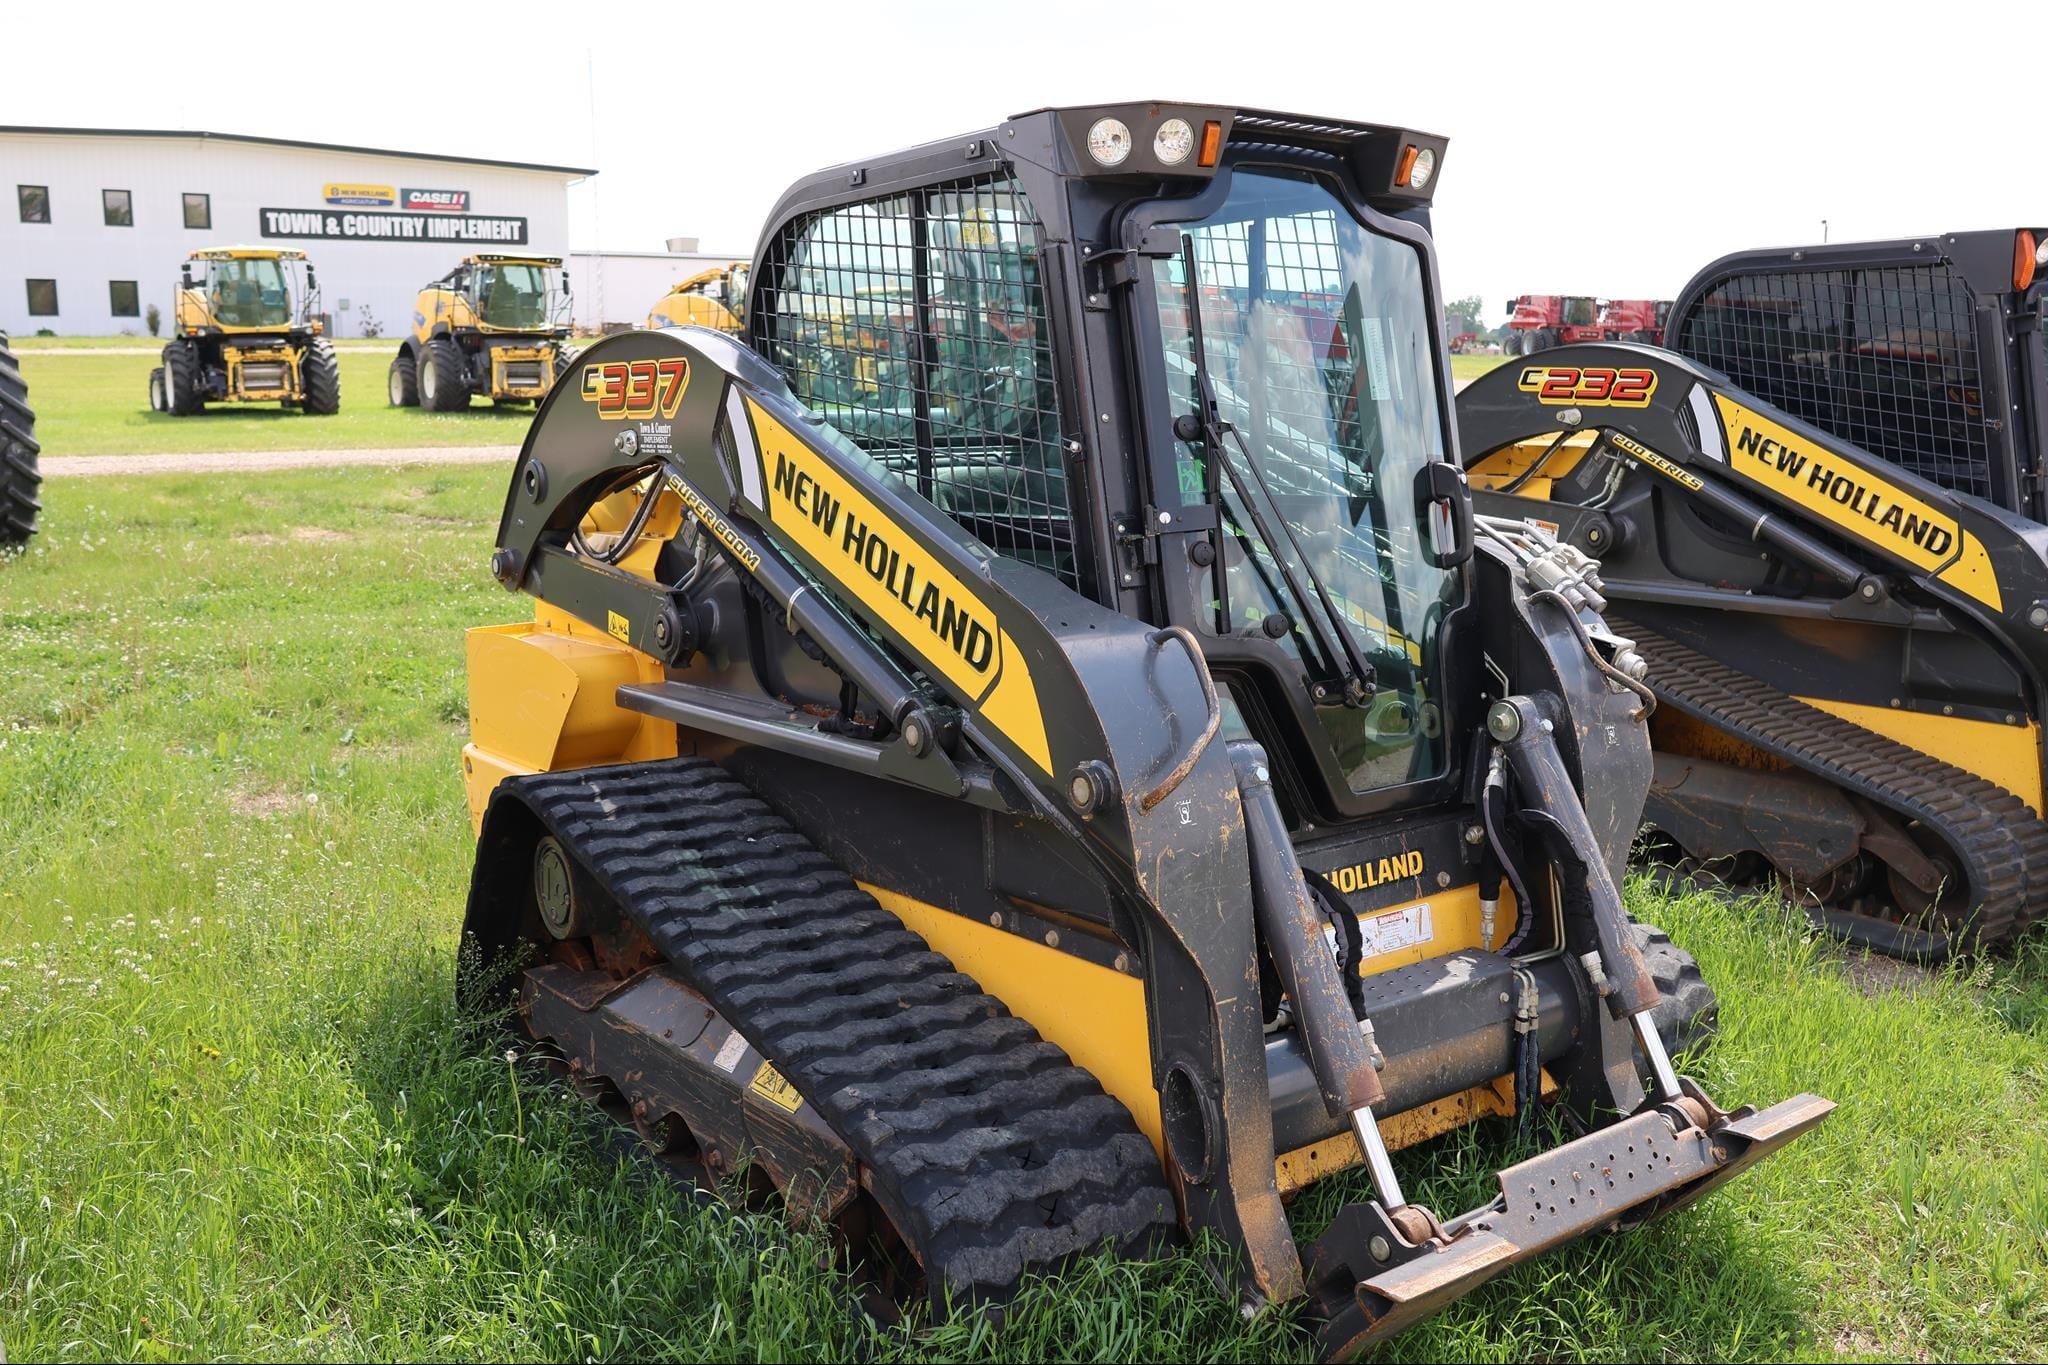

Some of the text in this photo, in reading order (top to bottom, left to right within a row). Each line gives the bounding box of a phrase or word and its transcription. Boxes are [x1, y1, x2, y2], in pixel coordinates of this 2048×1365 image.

[266, 212, 522, 241] TOWN & COUNTRY IMPLEMENT
[409, 192, 451, 204] CASE
[581, 357, 690, 420] C337
[1518, 366, 1658, 408] C232
[1613, 433, 1704, 490] 200 SERIES
[1737, 427, 1953, 556] NEW HOLLAND
[773, 451, 993, 673] NEW HOLLAND
